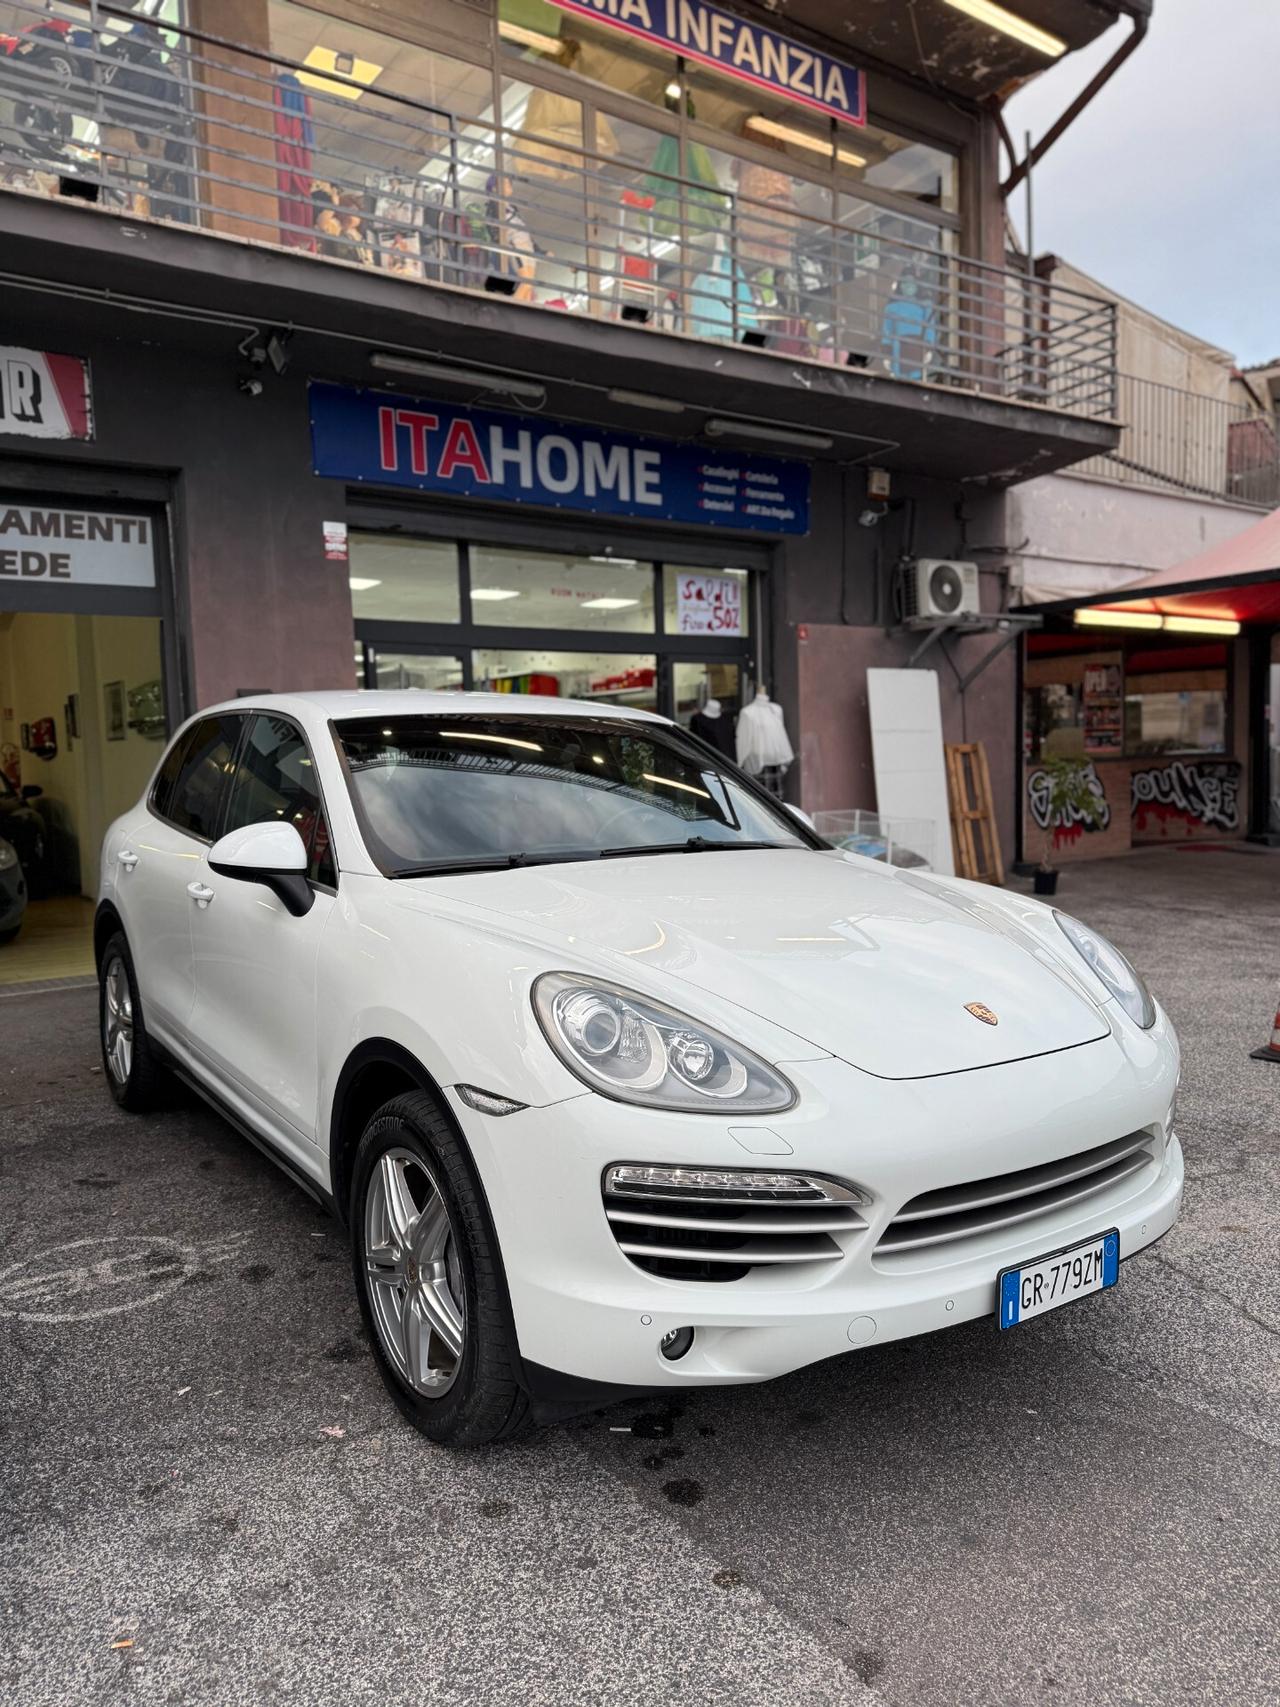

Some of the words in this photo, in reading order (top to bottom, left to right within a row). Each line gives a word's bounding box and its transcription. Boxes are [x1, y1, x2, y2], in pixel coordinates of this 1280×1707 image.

[666, 0, 849, 110] INFANZIA
[378, 406, 664, 507] ITAHOME
[0, 509, 147, 544] AMENTI
[0, 550, 71, 578] EDE
